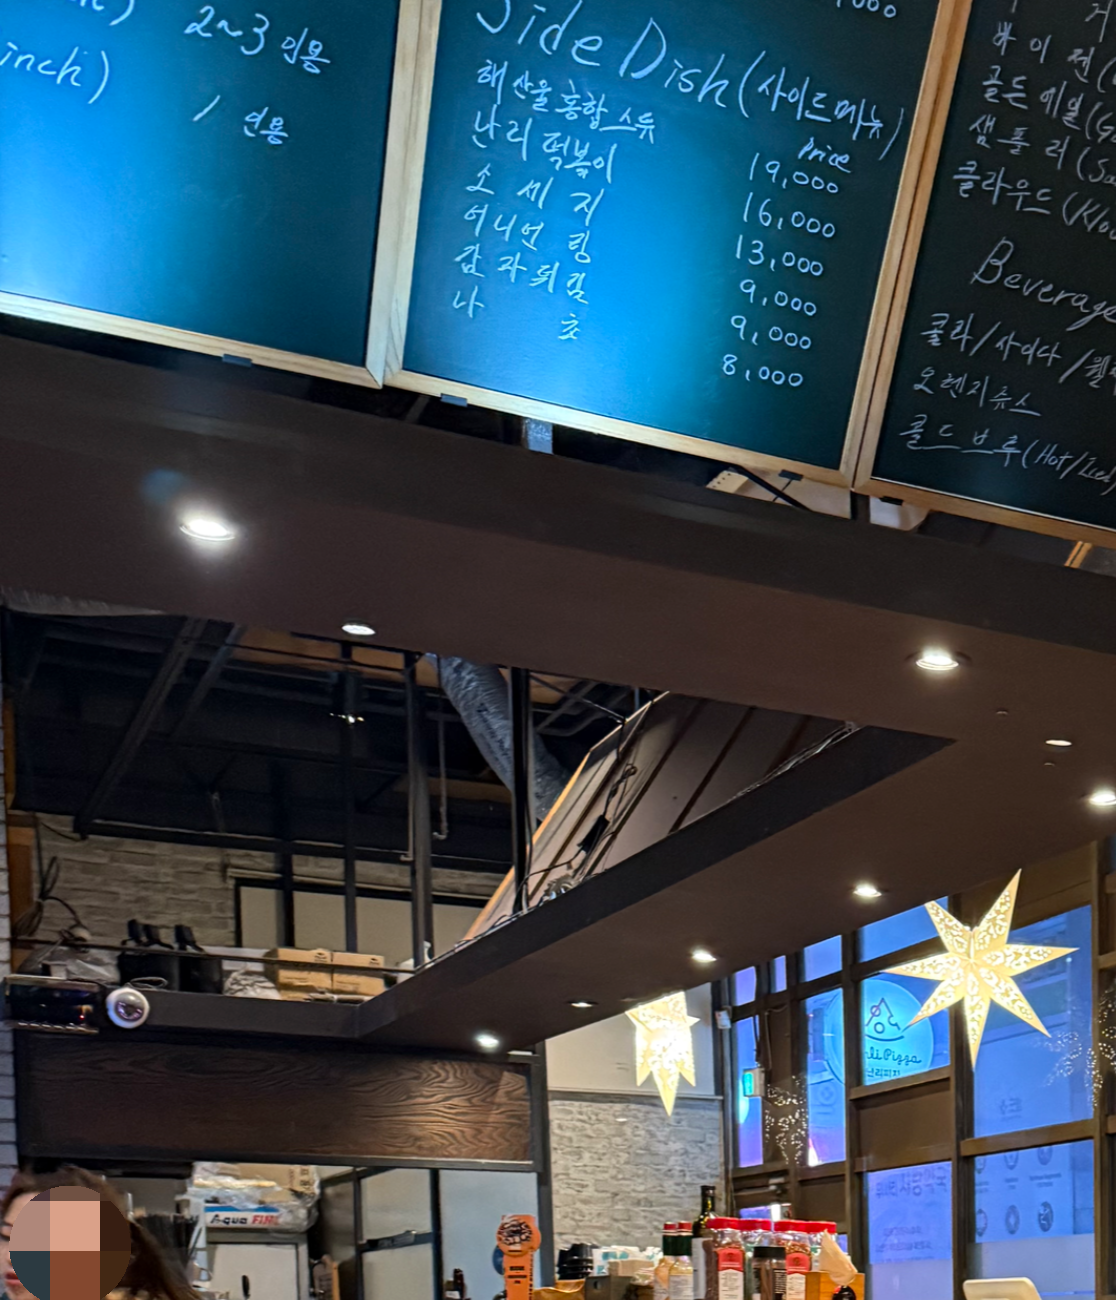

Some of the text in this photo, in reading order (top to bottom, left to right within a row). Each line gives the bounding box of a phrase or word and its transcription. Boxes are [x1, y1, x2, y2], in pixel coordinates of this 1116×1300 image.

[749, 152, 839, 194] 19,000
[743, 191, 835, 238] 16,000
[736, 234, 823, 276] 13,000
[740, 279, 817, 317] 9,000
[731, 315, 812, 350] 9,000
[722, 353, 804, 388] 8,000
